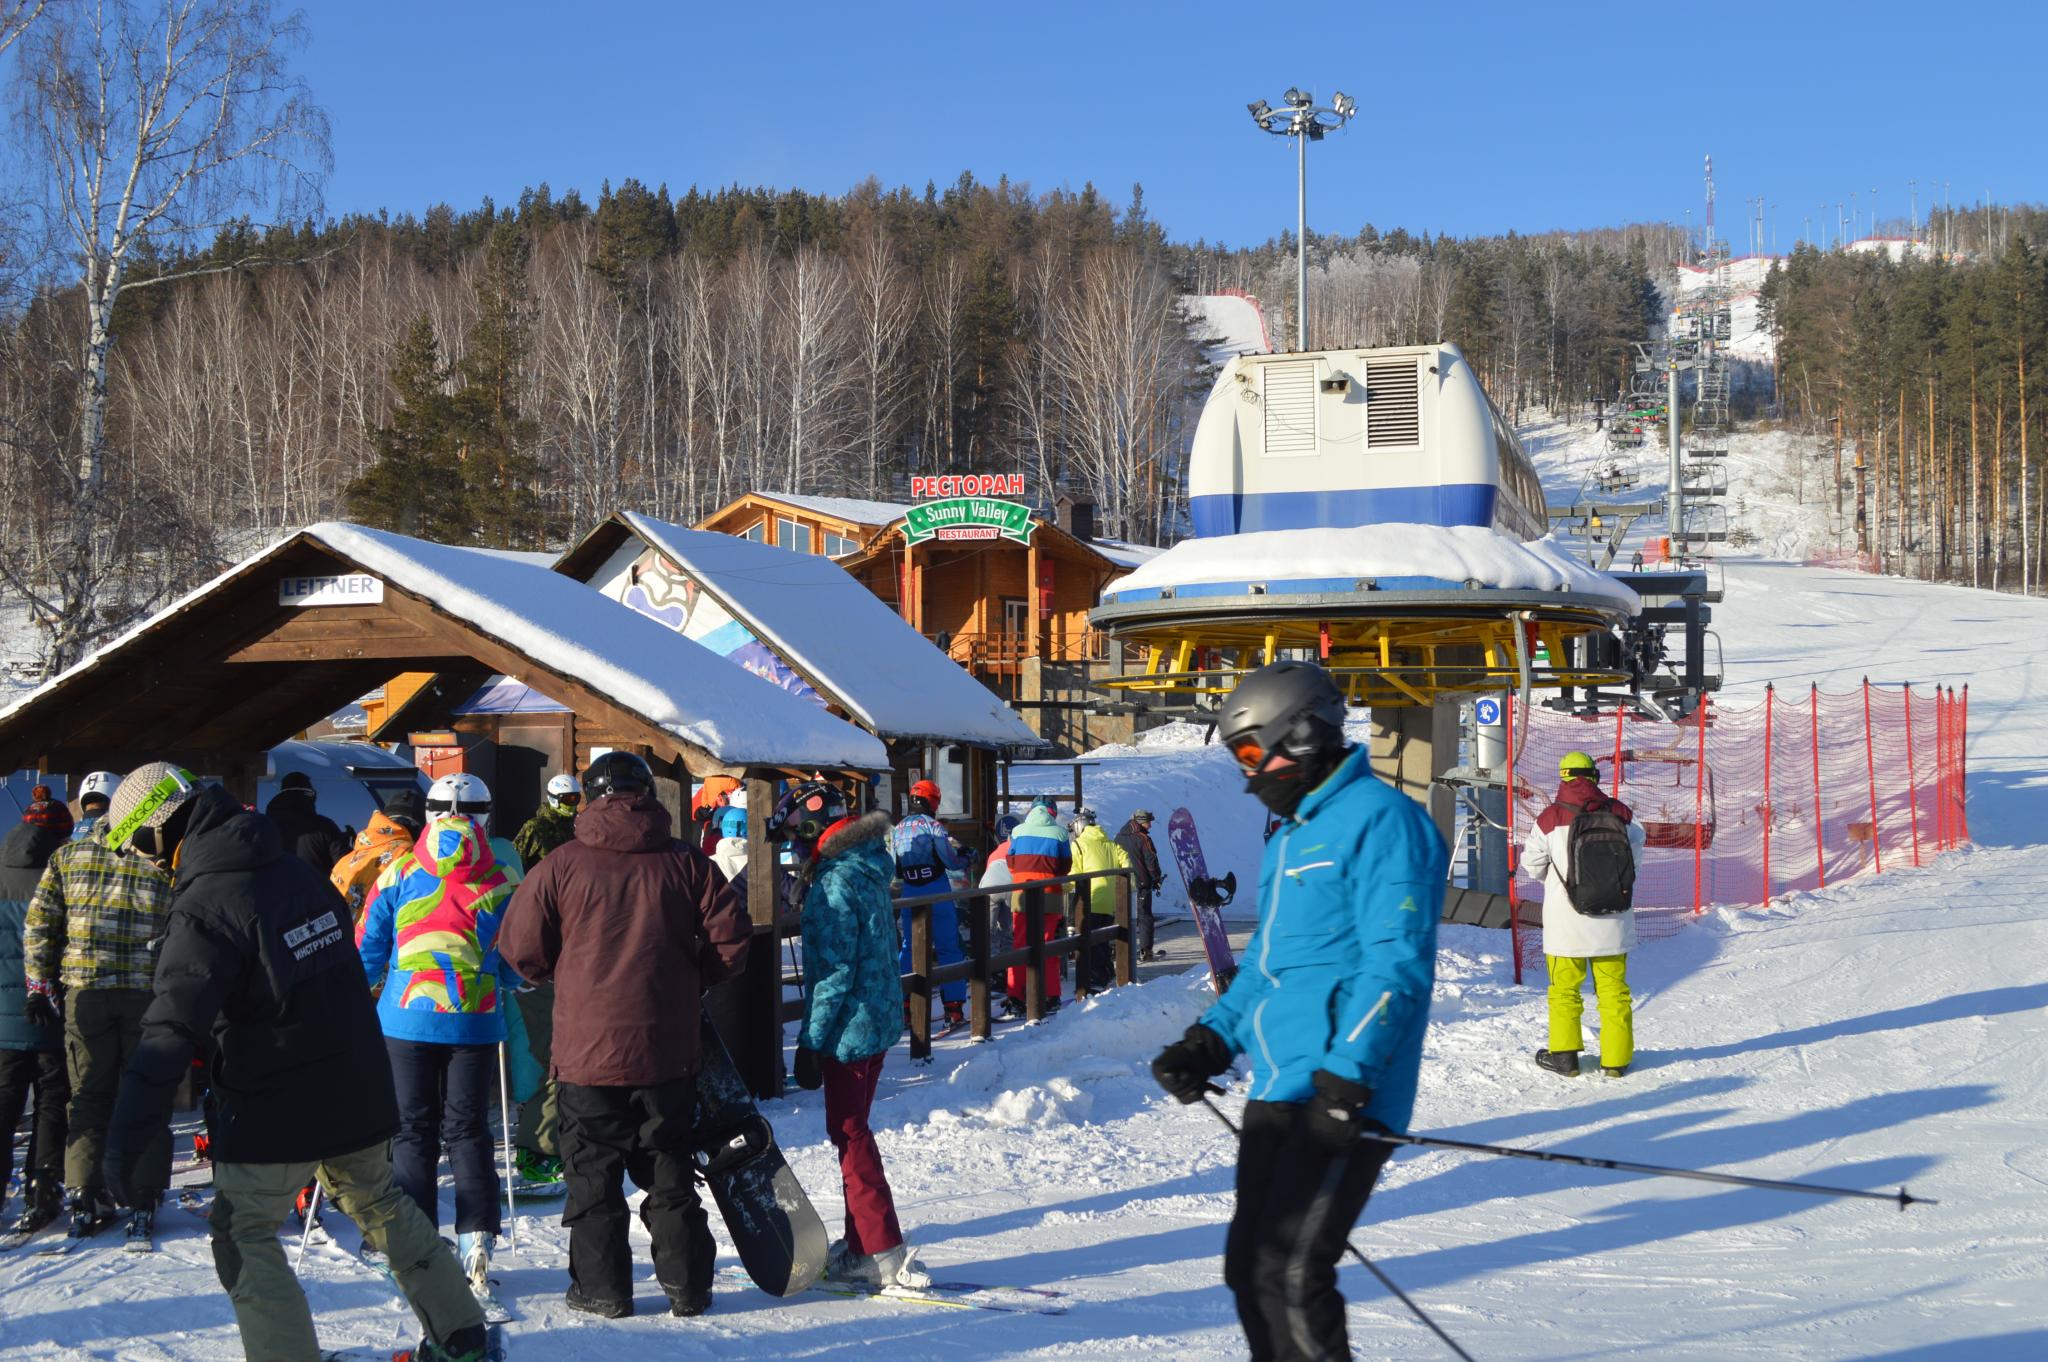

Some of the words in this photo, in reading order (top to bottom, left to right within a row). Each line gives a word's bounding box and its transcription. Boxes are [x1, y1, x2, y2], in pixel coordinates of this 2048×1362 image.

[911, 474, 1025, 497] РЕСТОРАН
[925, 506, 967, 523] Sunny
[971, 502, 1009, 525] Valley
[938, 529, 998, 540] RESTAURANT
[283, 577, 374, 597] LEITNER
[117, 788, 167, 838] DRAGON
[903, 867, 933, 881] US
